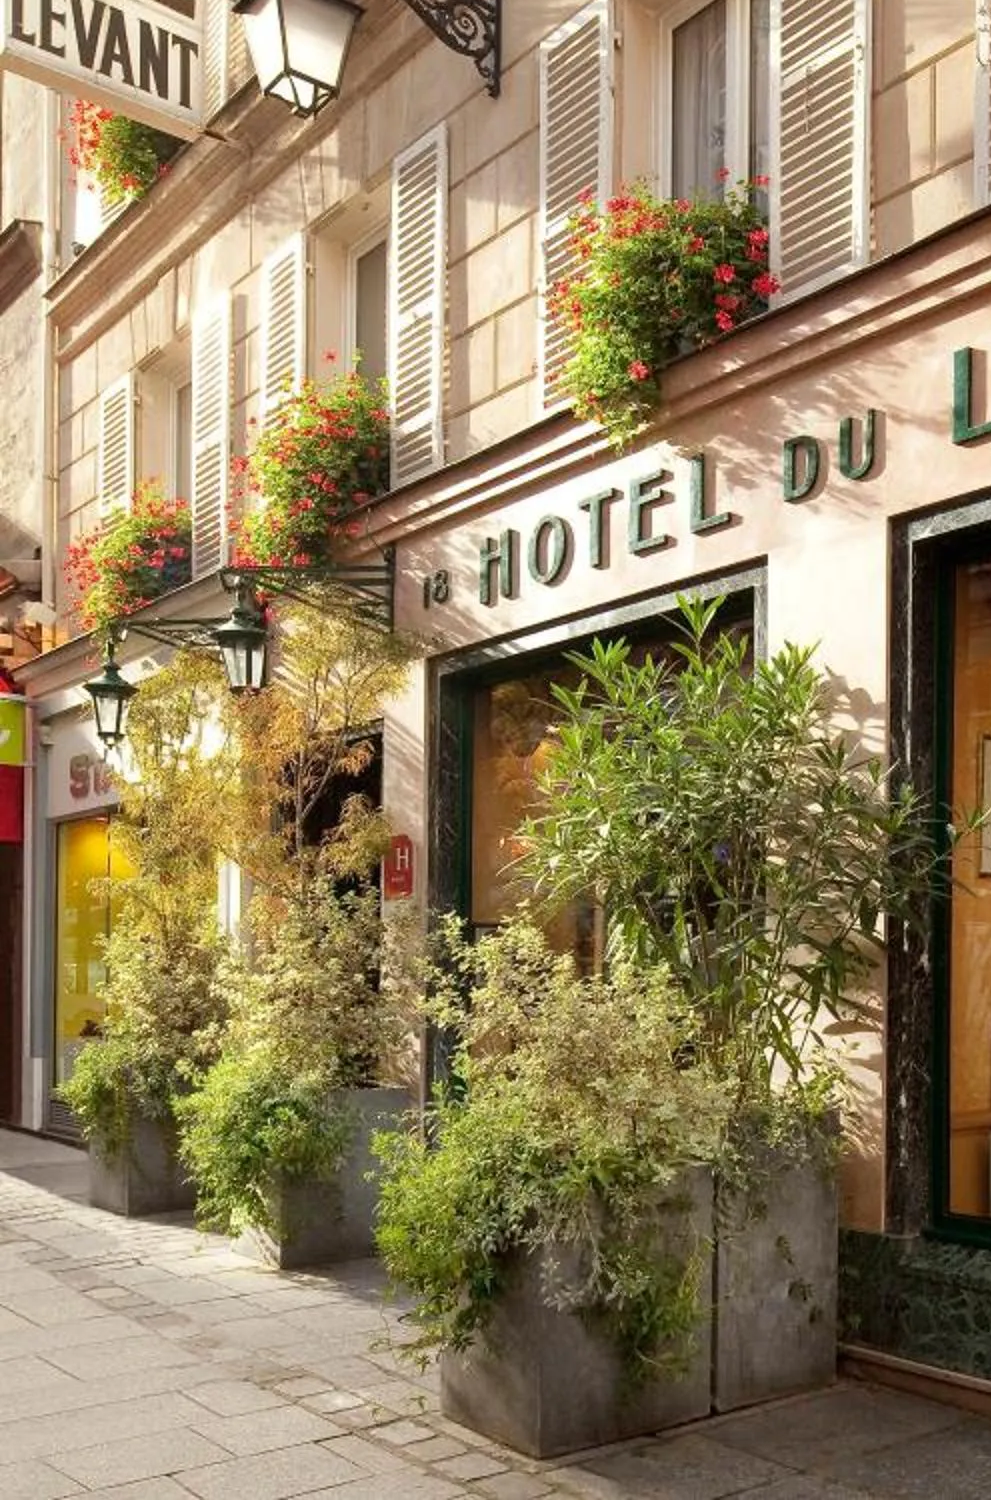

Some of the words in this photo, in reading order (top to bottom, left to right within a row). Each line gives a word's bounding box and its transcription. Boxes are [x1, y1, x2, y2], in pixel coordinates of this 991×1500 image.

[423, 569, 449, 610] 18
[479, 453, 732, 607] HOTEL
[783, 408, 877, 503] DU
[396, 847, 409, 871] H
